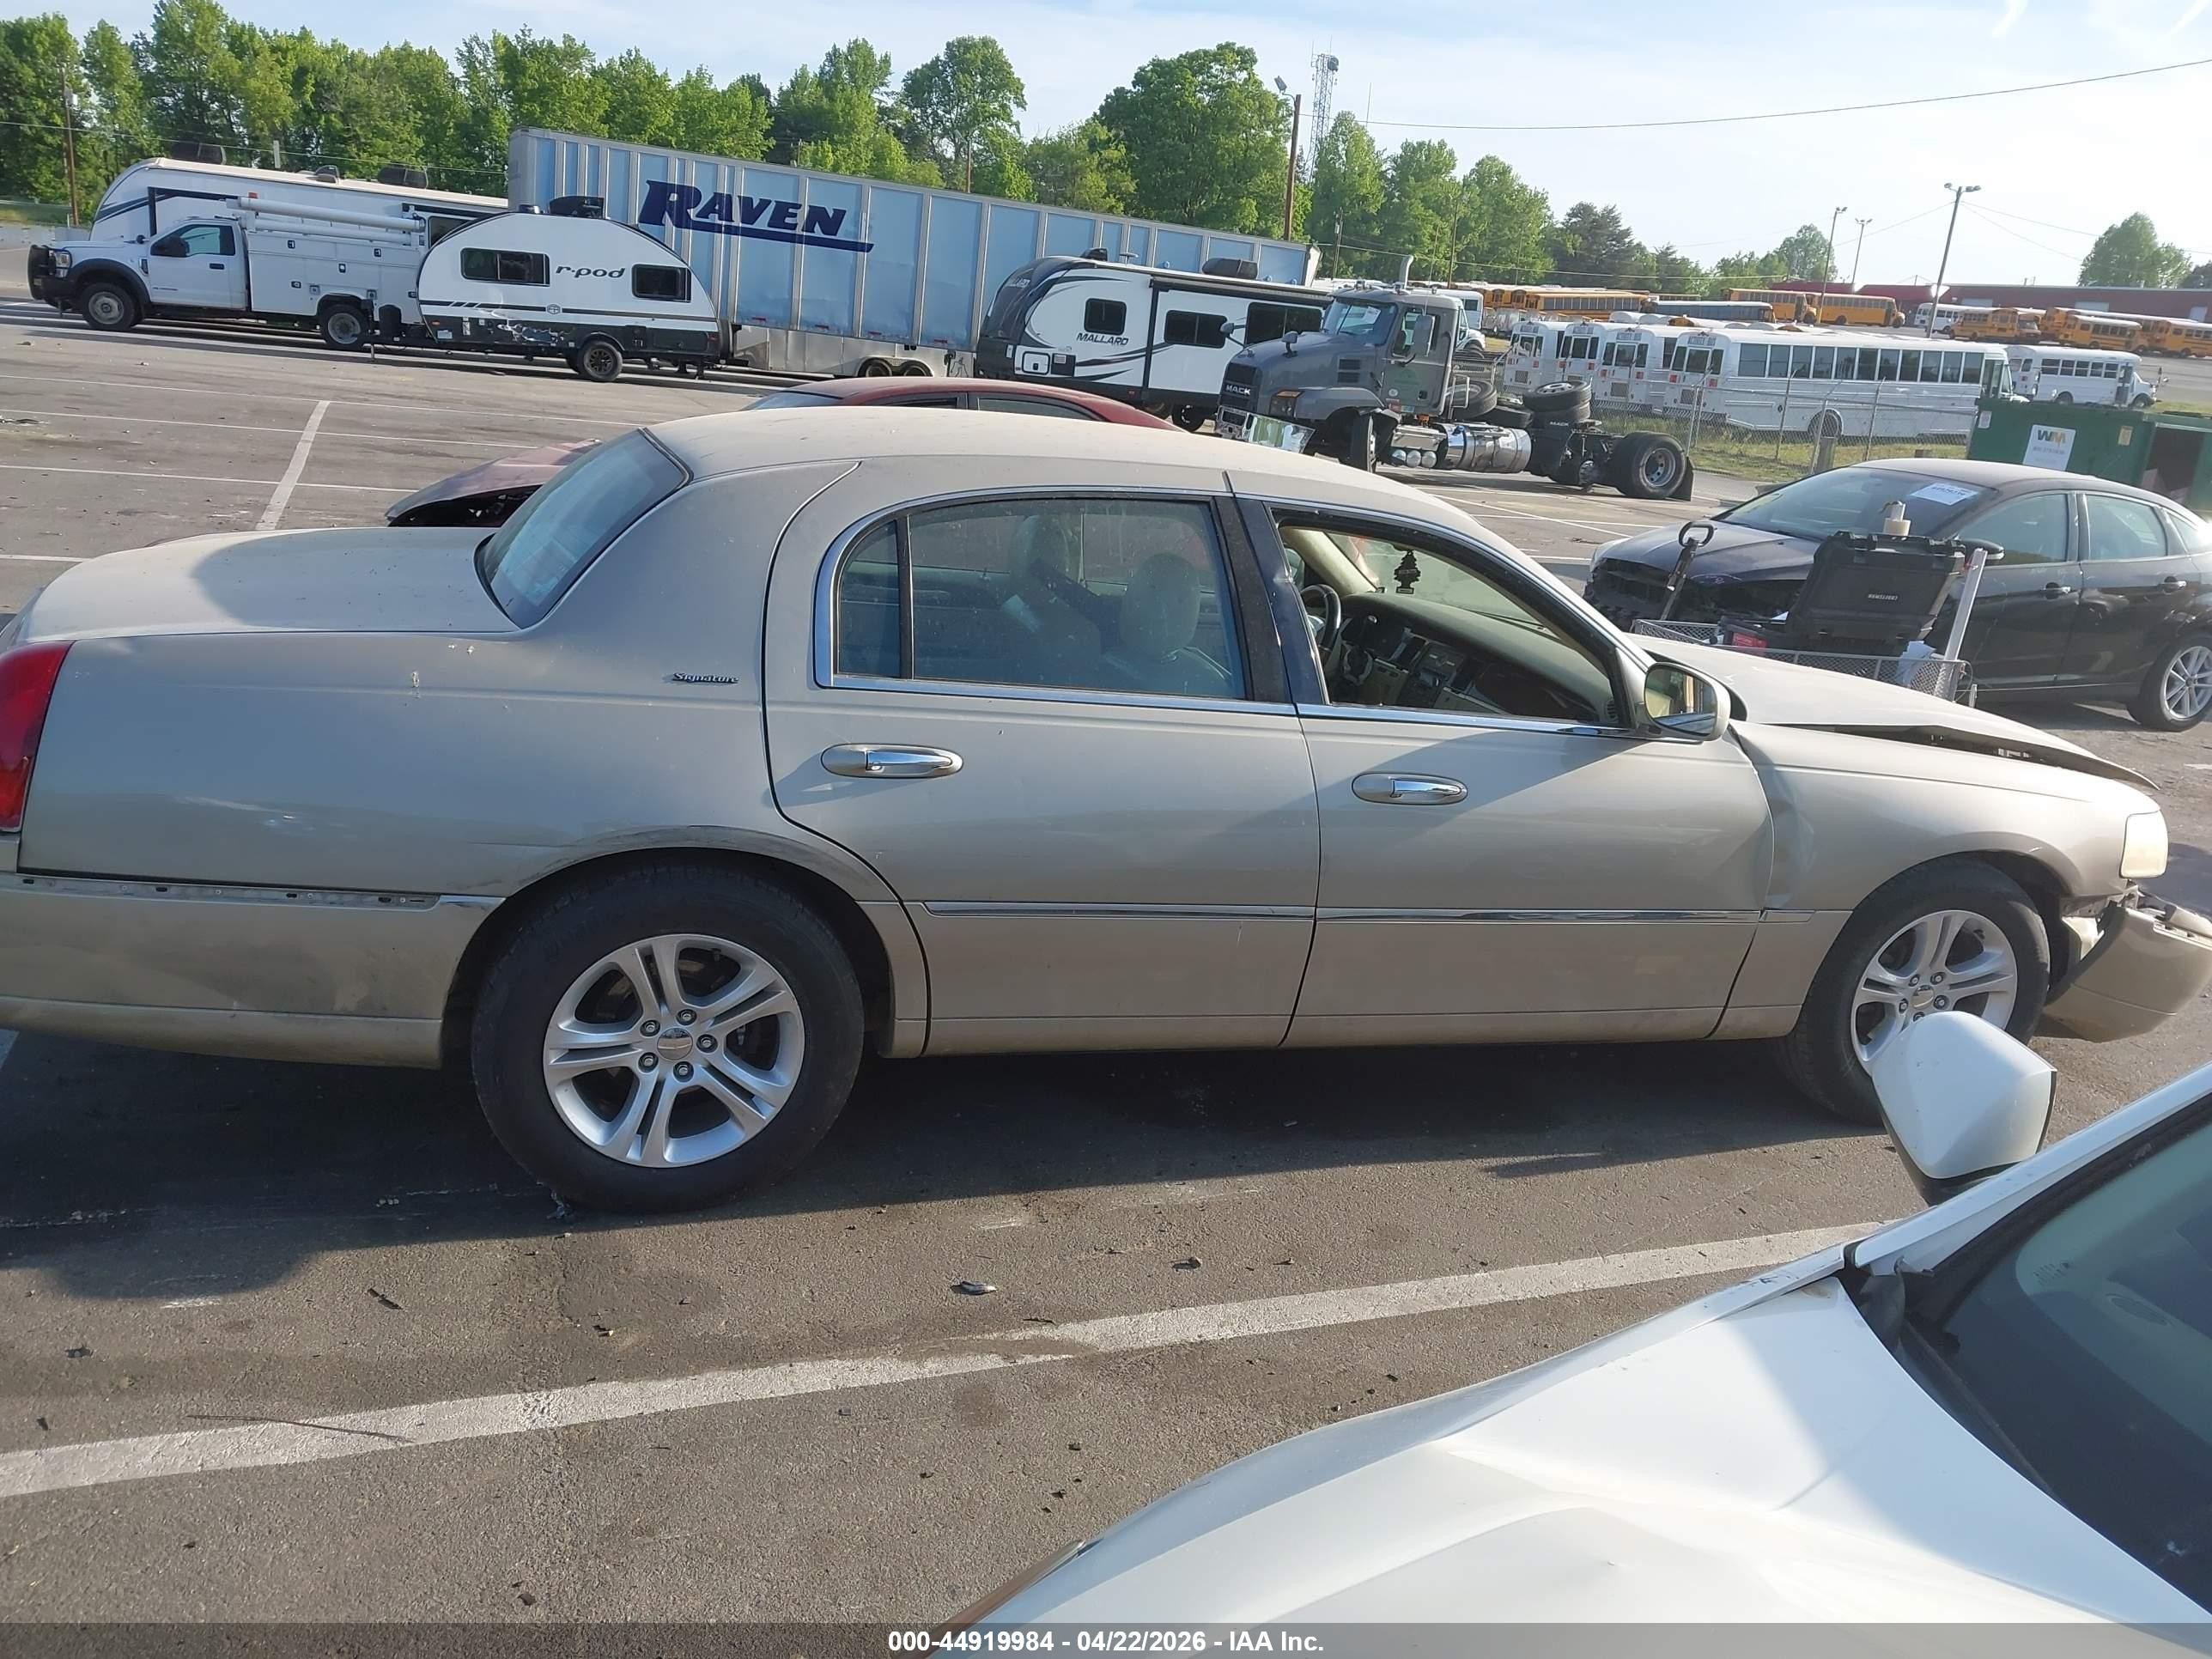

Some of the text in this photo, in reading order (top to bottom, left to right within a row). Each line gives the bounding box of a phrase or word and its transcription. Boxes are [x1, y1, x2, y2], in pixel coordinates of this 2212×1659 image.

[638, 179, 847, 238] RAVEN
[556, 265, 626, 278] r-pod
[1076, 332, 1129, 346] MALLARD
[1225, 384, 1251, 396] MACK
[2037, 429, 2066, 444] WM
[672, 672, 739, 684] Signature
